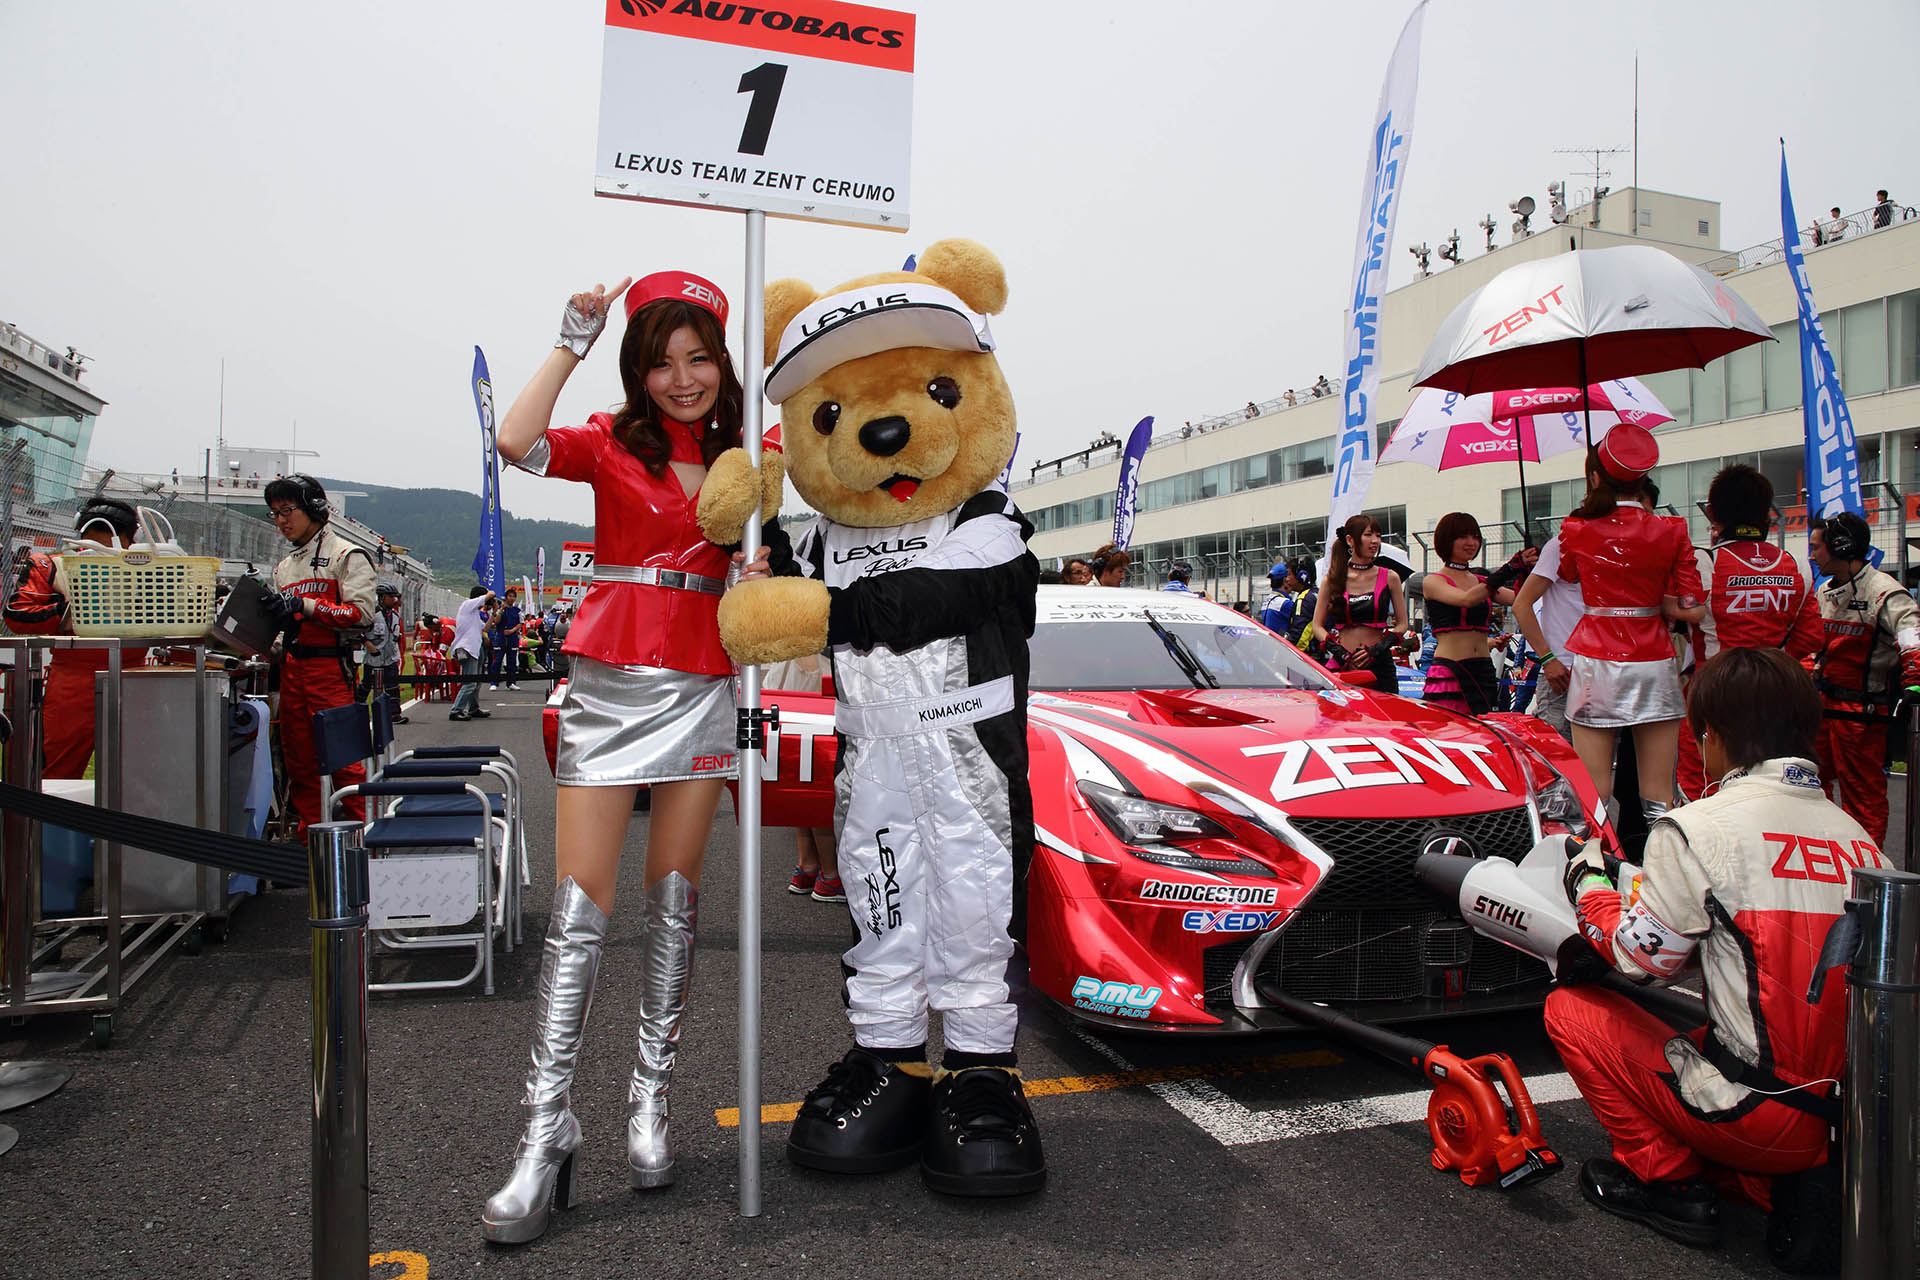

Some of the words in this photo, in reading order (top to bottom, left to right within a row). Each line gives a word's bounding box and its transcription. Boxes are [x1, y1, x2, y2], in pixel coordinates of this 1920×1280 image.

[670, 0, 904, 49] AUTOBACS
[737, 62, 789, 156] 1
[614, 152, 684, 176] LEXUS
[691, 161, 748, 184] TEAM
[752, 169, 807, 192] ZENT
[812, 177, 896, 203] CERUMO
[682, 281, 726, 311] ZENT
[801, 293, 910, 337] LEXUS
[1483, 284, 1564, 346] ZENT
[1509, 393, 1581, 408] EXEDY
[569, 553, 594, 568] 37
[833, 536, 928, 564] LEXUS
[864, 554, 917, 578] Raci
[1727, 575, 1794, 587] BRIDGESTONE
[1725, 589, 1797, 613] ZENT
[918, 697, 983, 722] KUMAKICHI
[692, 754, 735, 771] ZENT
[1241, 736, 1509, 803] ZENT
[1762, 832, 1882, 884] ZENT
[876, 828, 902, 929] LEXUS
[1141, 880, 1277, 904] BRIDGESTONE
[1184, 911, 1281, 932] EXEDY
[1473, 895, 1529, 932] STIHL
[1074, 999, 1115, 1014] RACING
[1117, 1007, 1150, 1018] PADS
